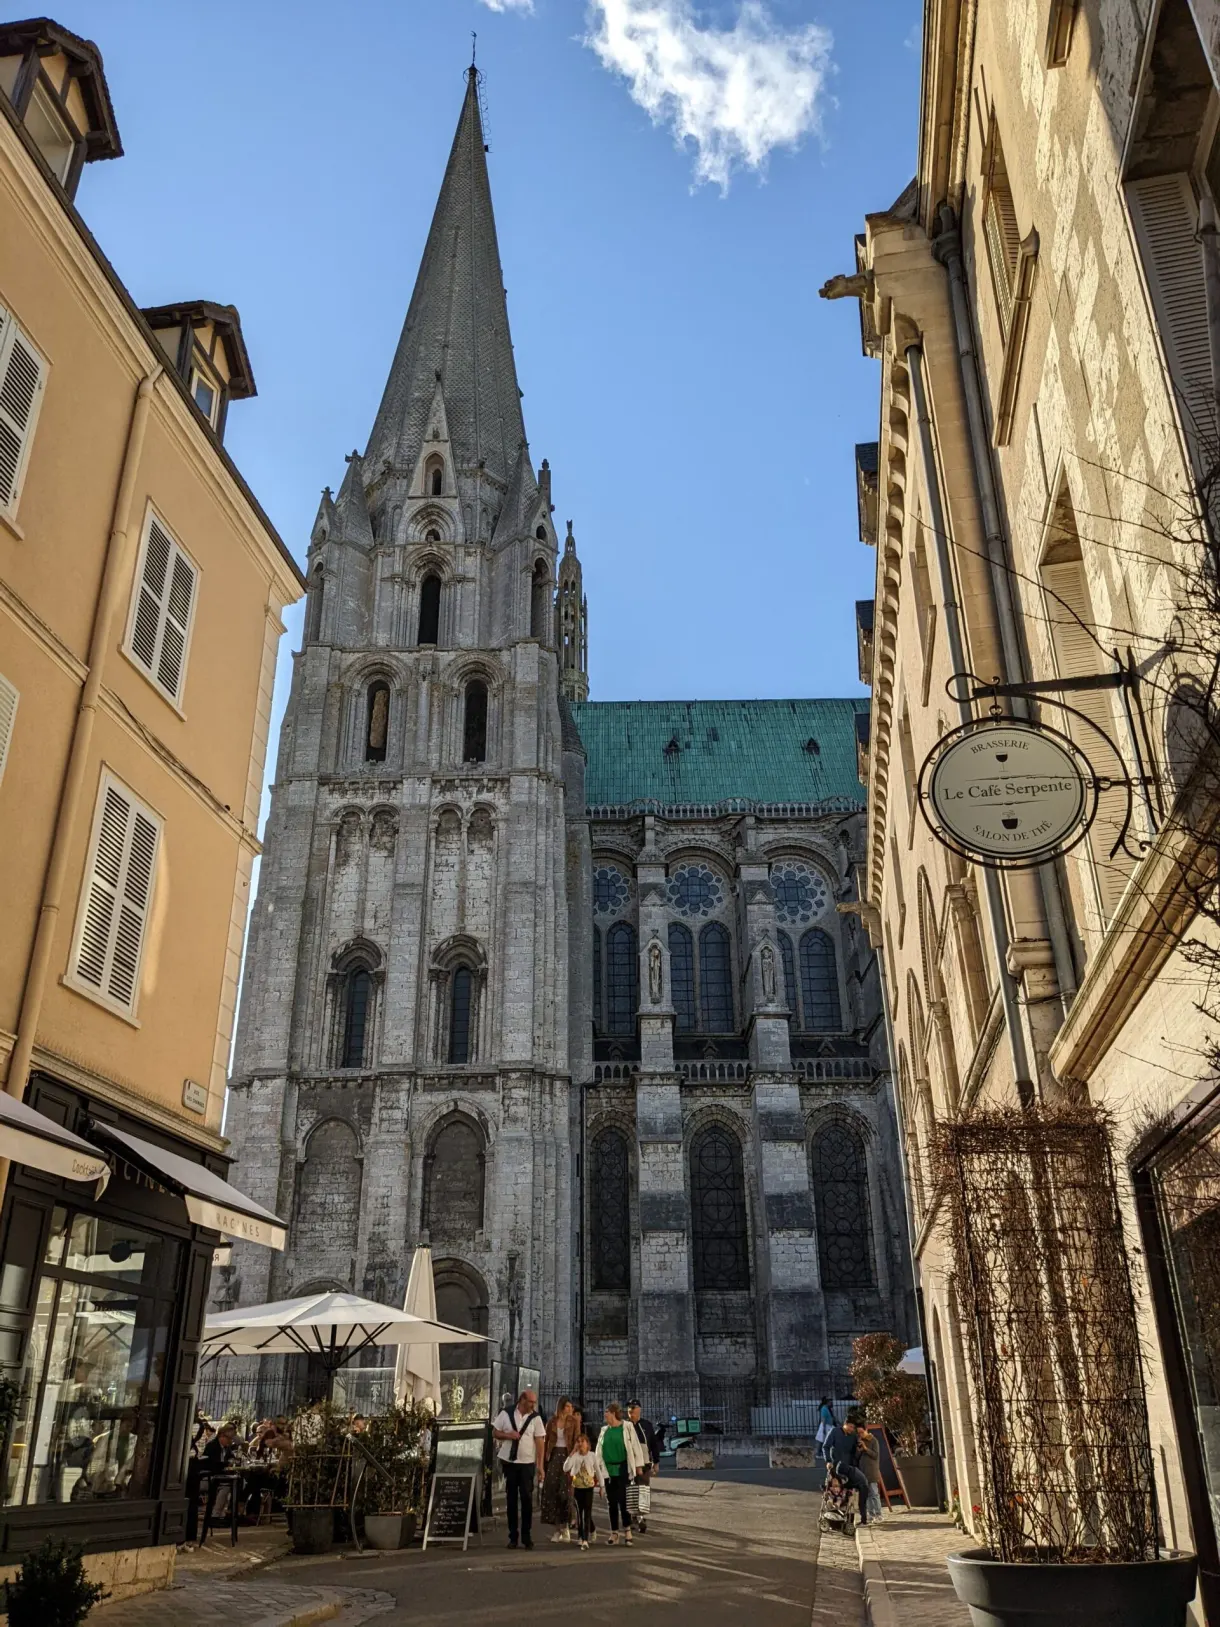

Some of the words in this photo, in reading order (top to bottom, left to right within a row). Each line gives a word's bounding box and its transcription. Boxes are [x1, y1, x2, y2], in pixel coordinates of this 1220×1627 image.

[970, 740, 1030, 754] BRASSERIE
[944, 788, 964, 800] Le
[968, 784, 1002, 798] Café
[1005, 781, 1073, 797] Serpente
[973, 825, 1010, 842] SALON
[1013, 832, 1030, 841] DE
